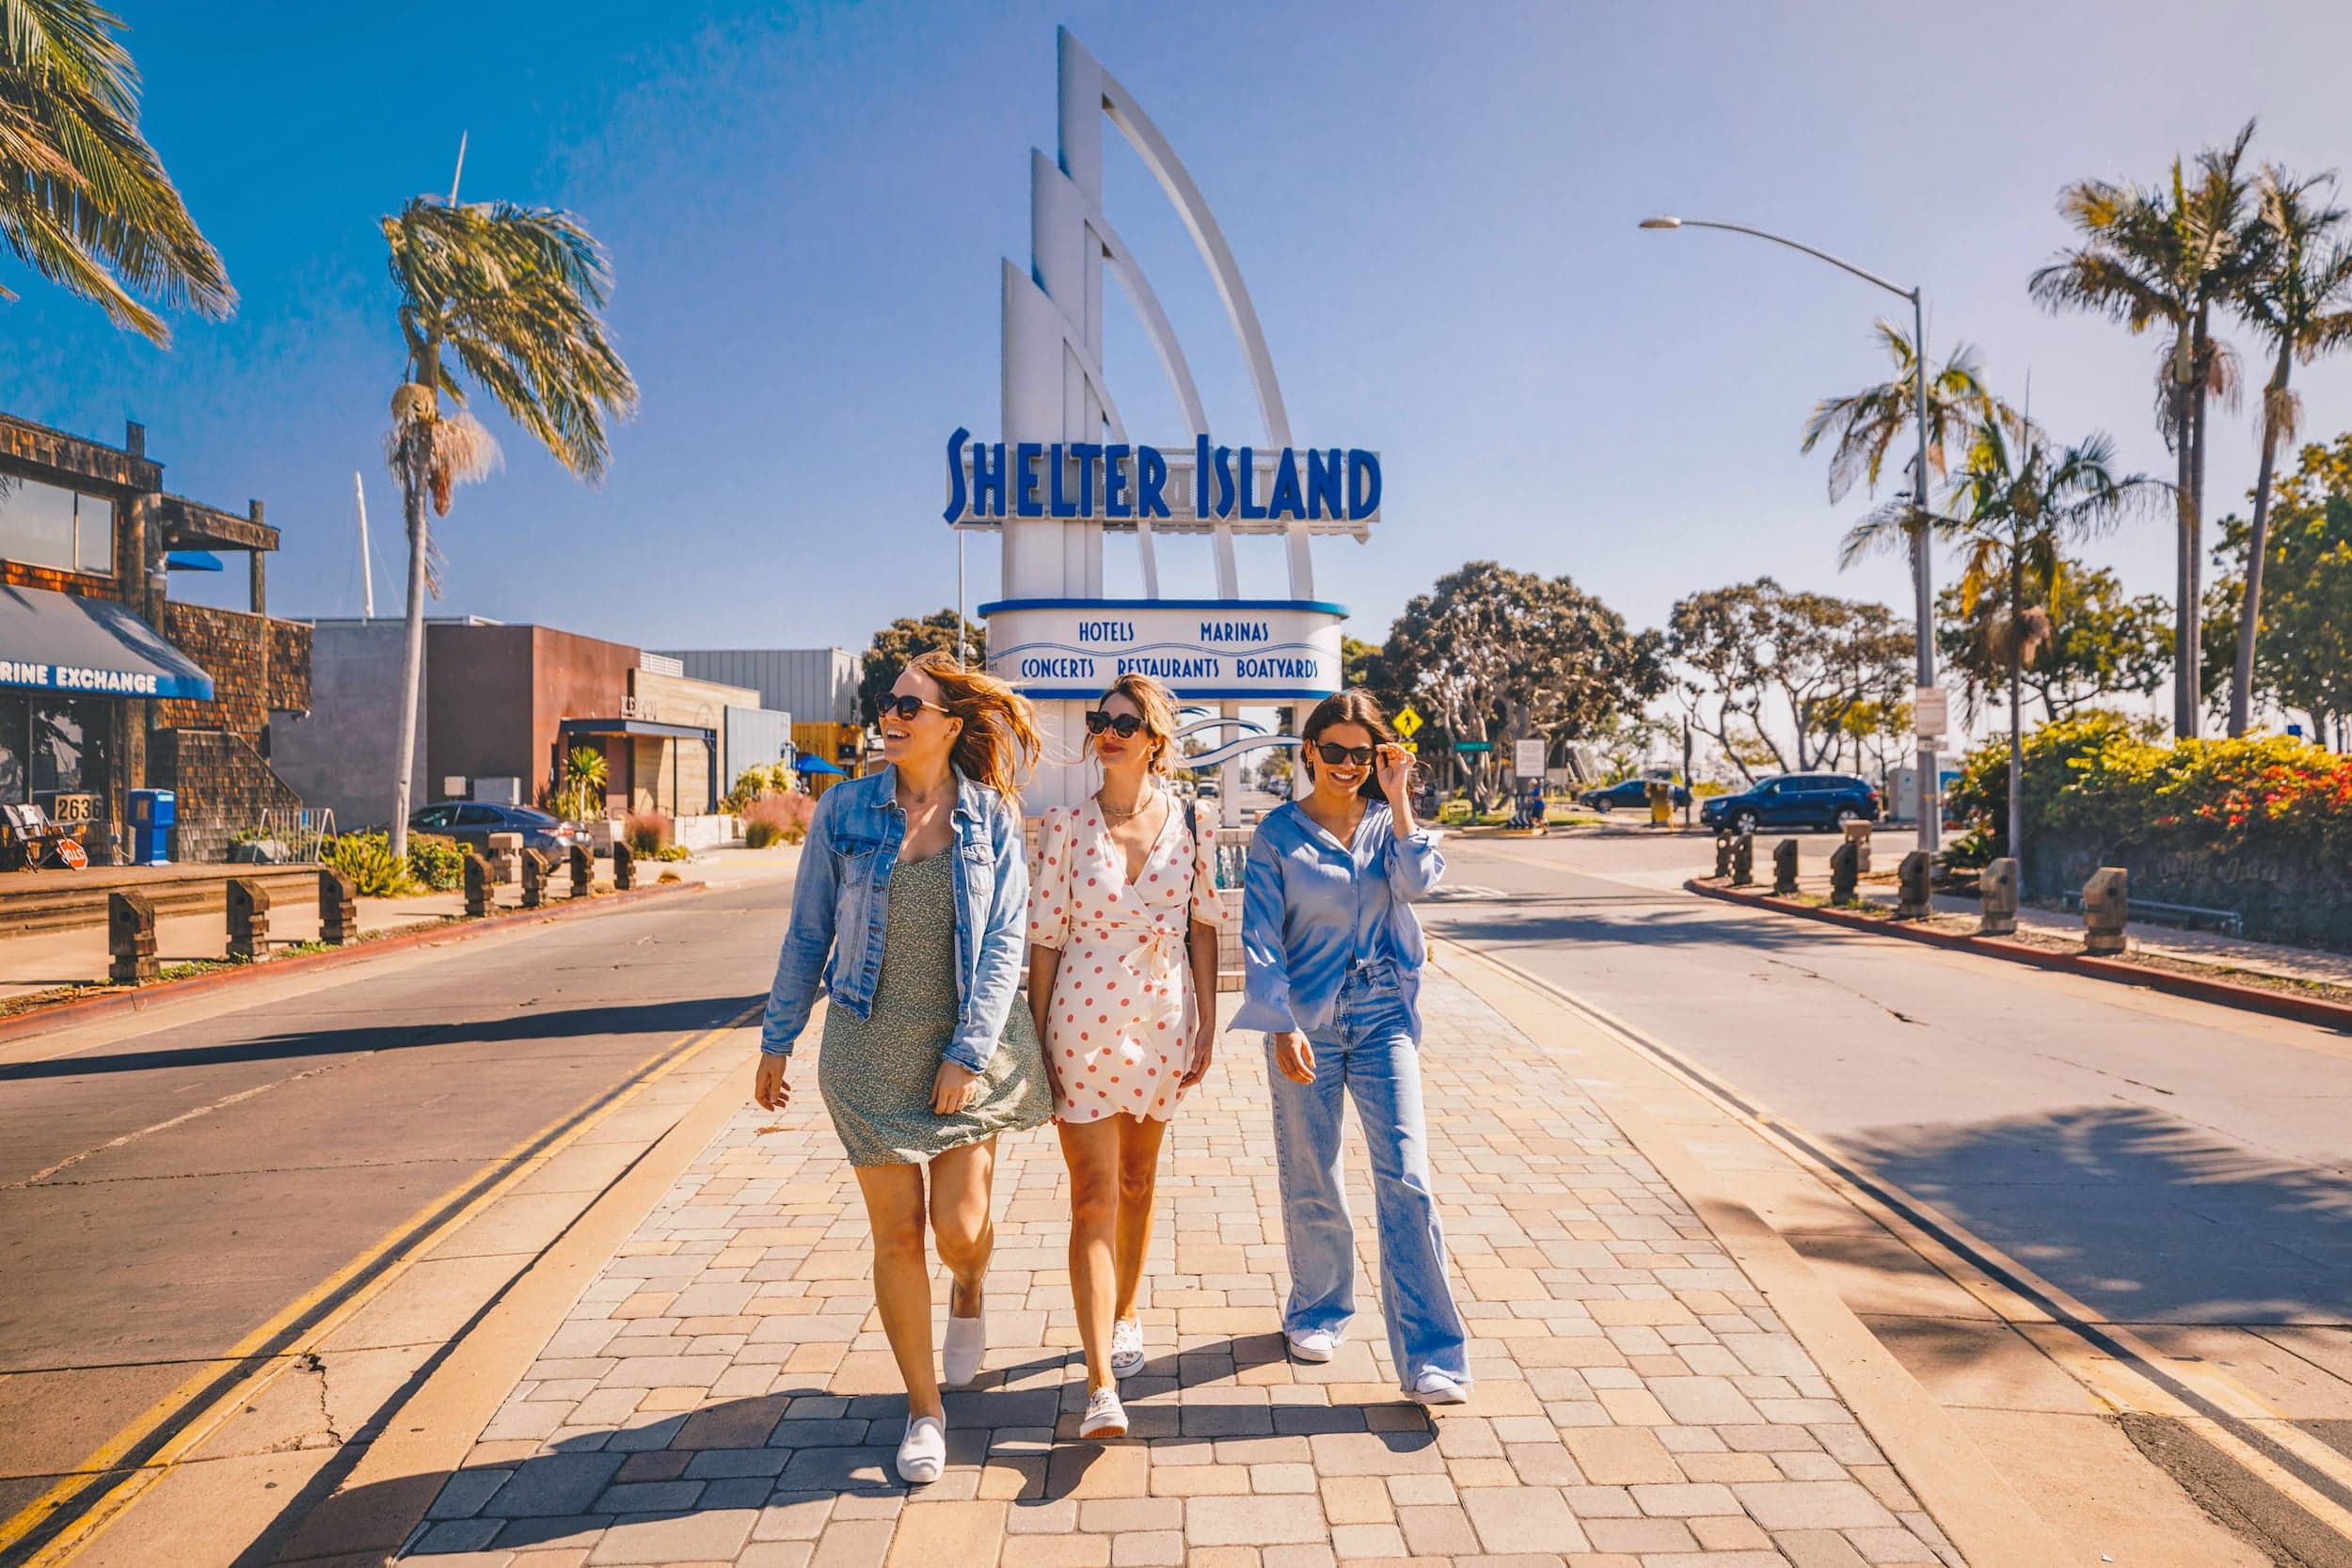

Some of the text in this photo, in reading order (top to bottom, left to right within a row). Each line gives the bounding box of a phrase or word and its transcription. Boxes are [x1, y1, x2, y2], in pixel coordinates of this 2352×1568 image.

[943, 426, 1382, 525] SHELTER ISLAND
[1079, 622, 1269, 641] HOTELS MARINAS
[0, 660, 157, 694] RINE EXCHANGE
[1022, 658, 1095, 678] CONCERTS
[1118, 657, 1219, 678] RESTAURANTS
[1236, 658, 1318, 678] BOATYARDS
[58, 799, 103, 820] 2636
